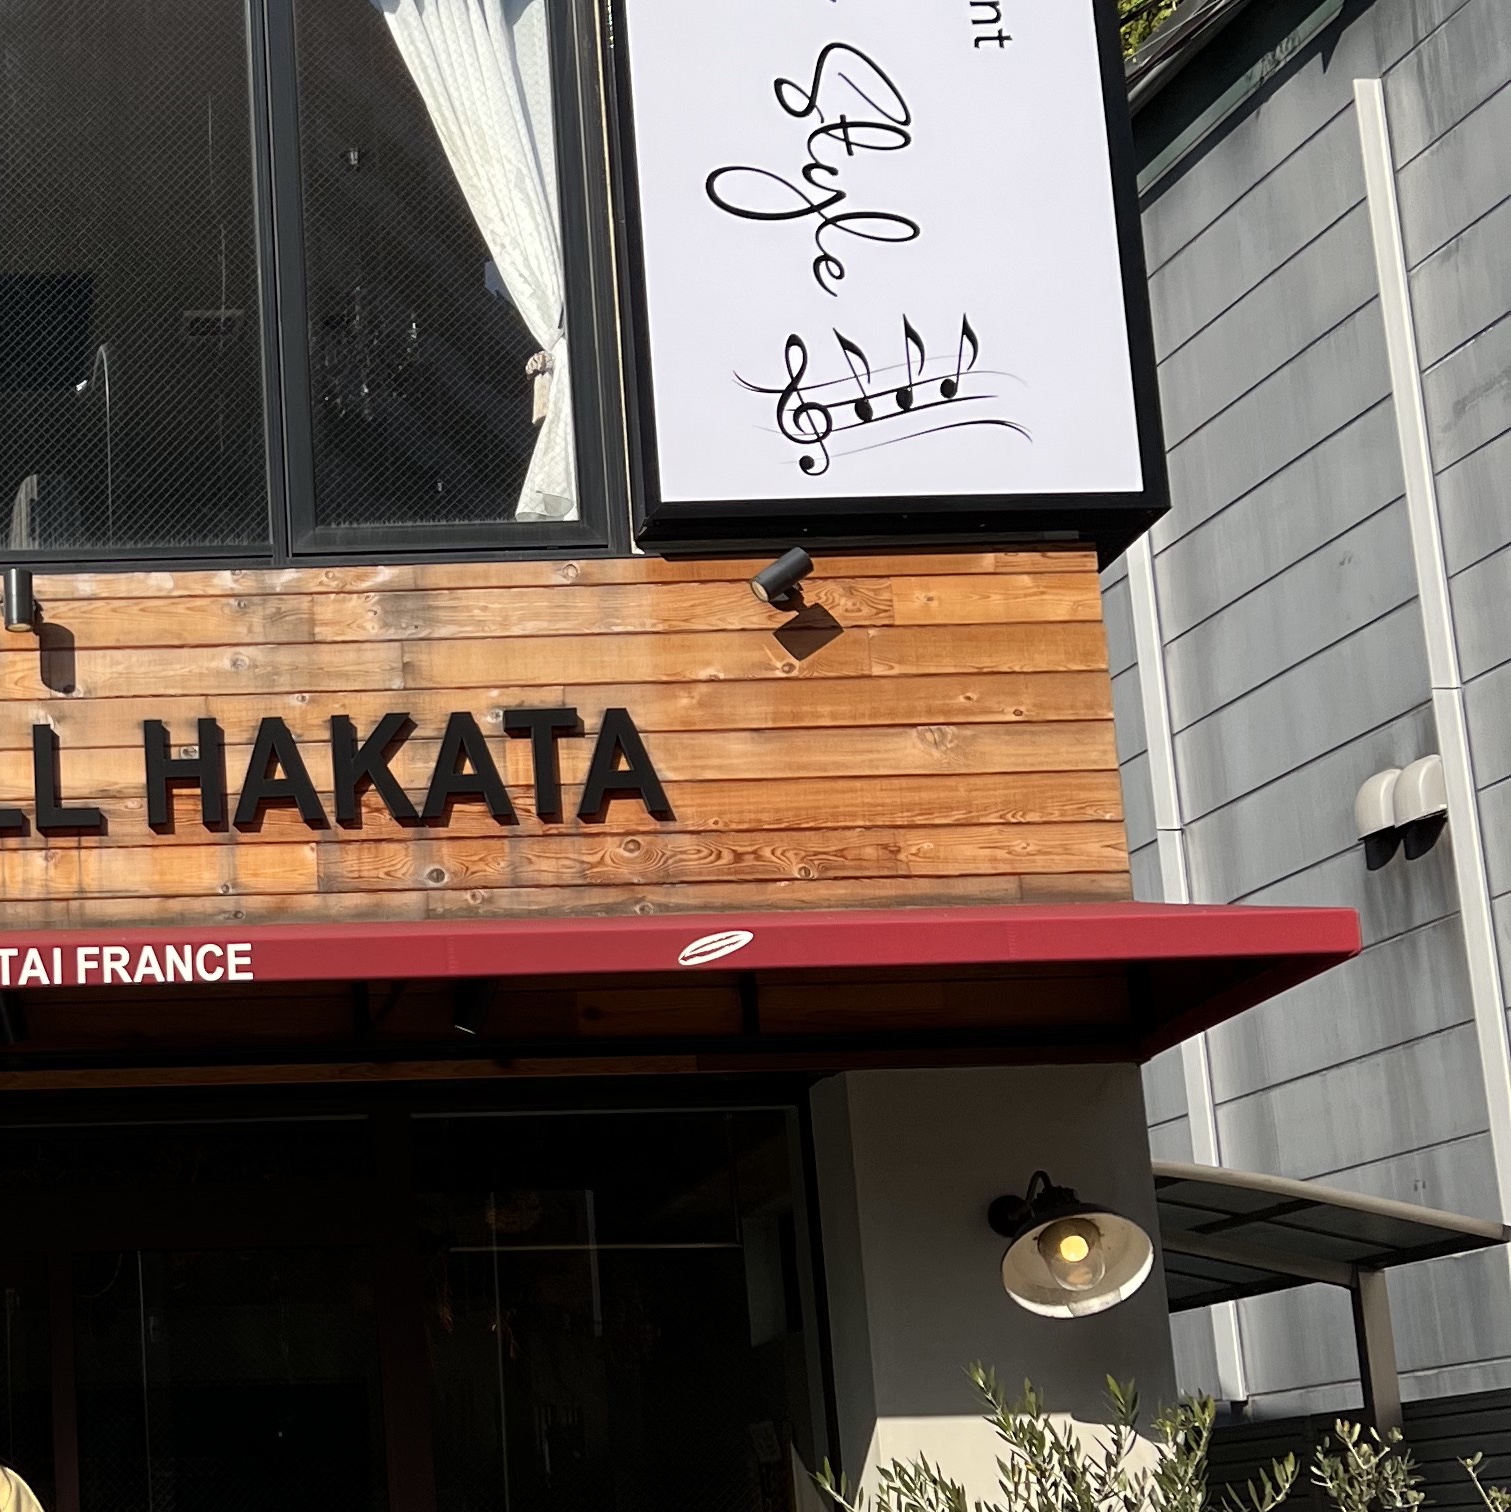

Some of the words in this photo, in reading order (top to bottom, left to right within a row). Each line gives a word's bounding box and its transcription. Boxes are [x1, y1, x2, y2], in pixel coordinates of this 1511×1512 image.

[705, 42, 921, 298] Style
[143, 707, 677, 835] HAKATA
[77, 942, 254, 984] FRANCE
